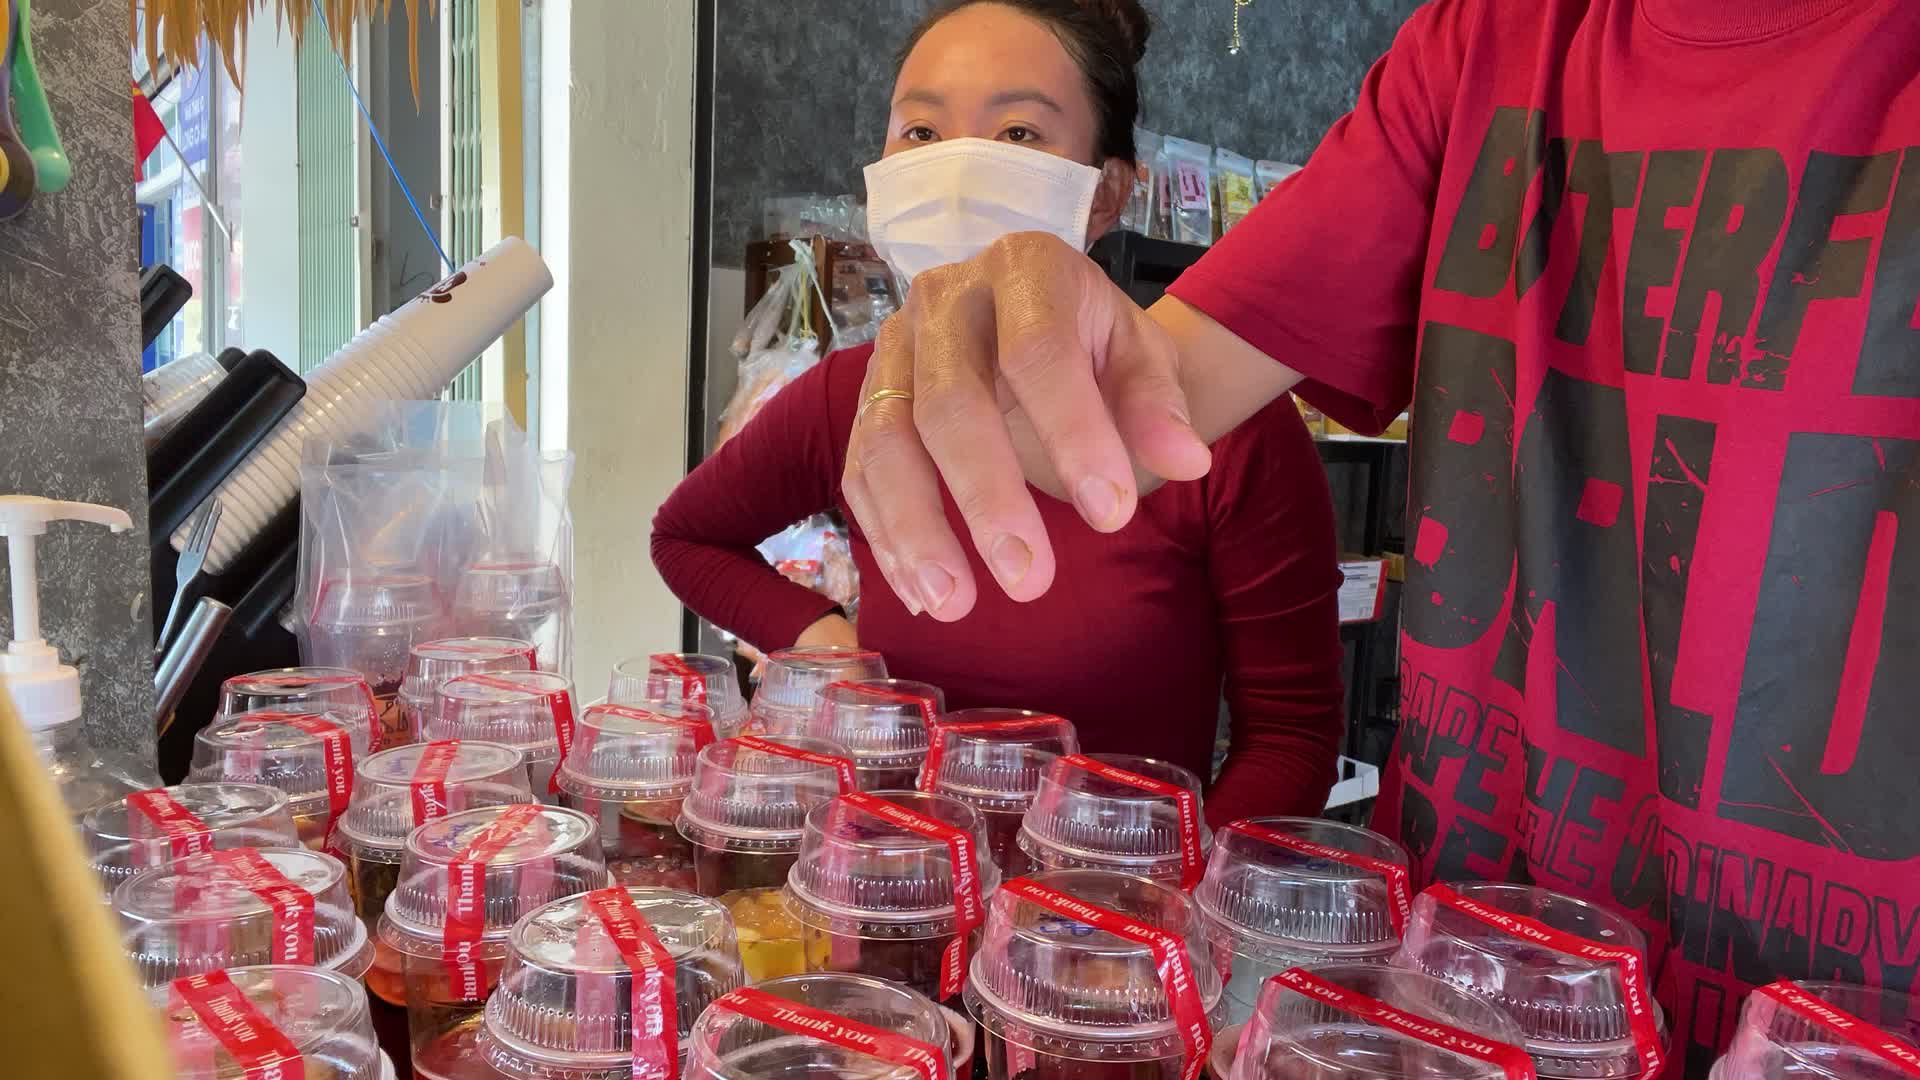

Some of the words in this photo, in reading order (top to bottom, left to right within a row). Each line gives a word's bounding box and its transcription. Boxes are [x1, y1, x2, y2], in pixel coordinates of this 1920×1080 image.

[1184, 836, 1197, 867] you
[1023, 885, 1057, 902] you
[1050, 894, 1104, 923] Thank
[1123, 923, 1163, 940] you
[1455, 899, 1514, 926] Thank
[1512, 922, 1552, 942] you
[280, 922, 300, 961] you
[947, 935, 963, 981] hank
[1156, 934, 1190, 998] Thank
[1580, 945, 1638, 971] Thank
[1623, 974, 1643, 1016] you
[1298, 979, 1344, 1001] you
[206, 994, 245, 1026] Thank
[771, 1006, 836, 1034] Thank
[829, 1026, 876, 1046] you
[1788, 993, 1855, 1030] Thank
[1374, 1007, 1446, 1039] Thank
[1441, 1034, 1494, 1056] you
